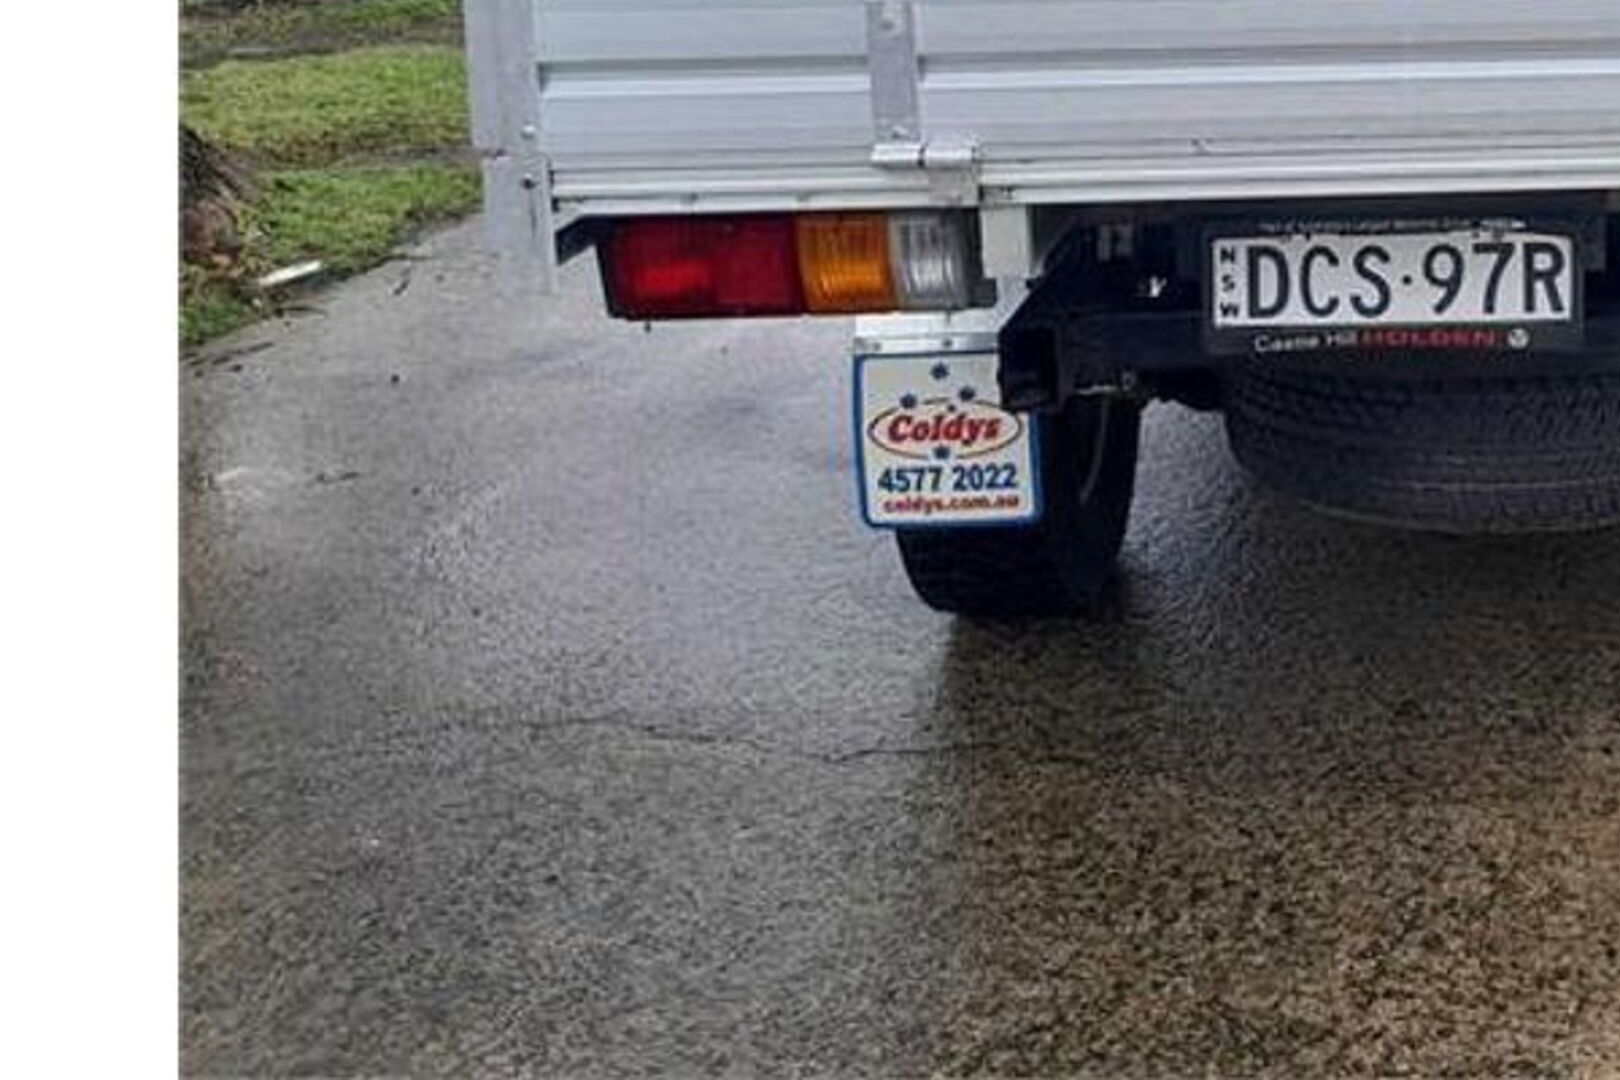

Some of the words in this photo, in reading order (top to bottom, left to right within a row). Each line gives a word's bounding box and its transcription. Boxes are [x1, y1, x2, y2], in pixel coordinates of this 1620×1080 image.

[888, 414, 1002, 445] Coldys
[877, 465, 943, 493] 4577
[952, 462, 1018, 491] 2022
[883, 495, 1019, 513] coldys.com.au
